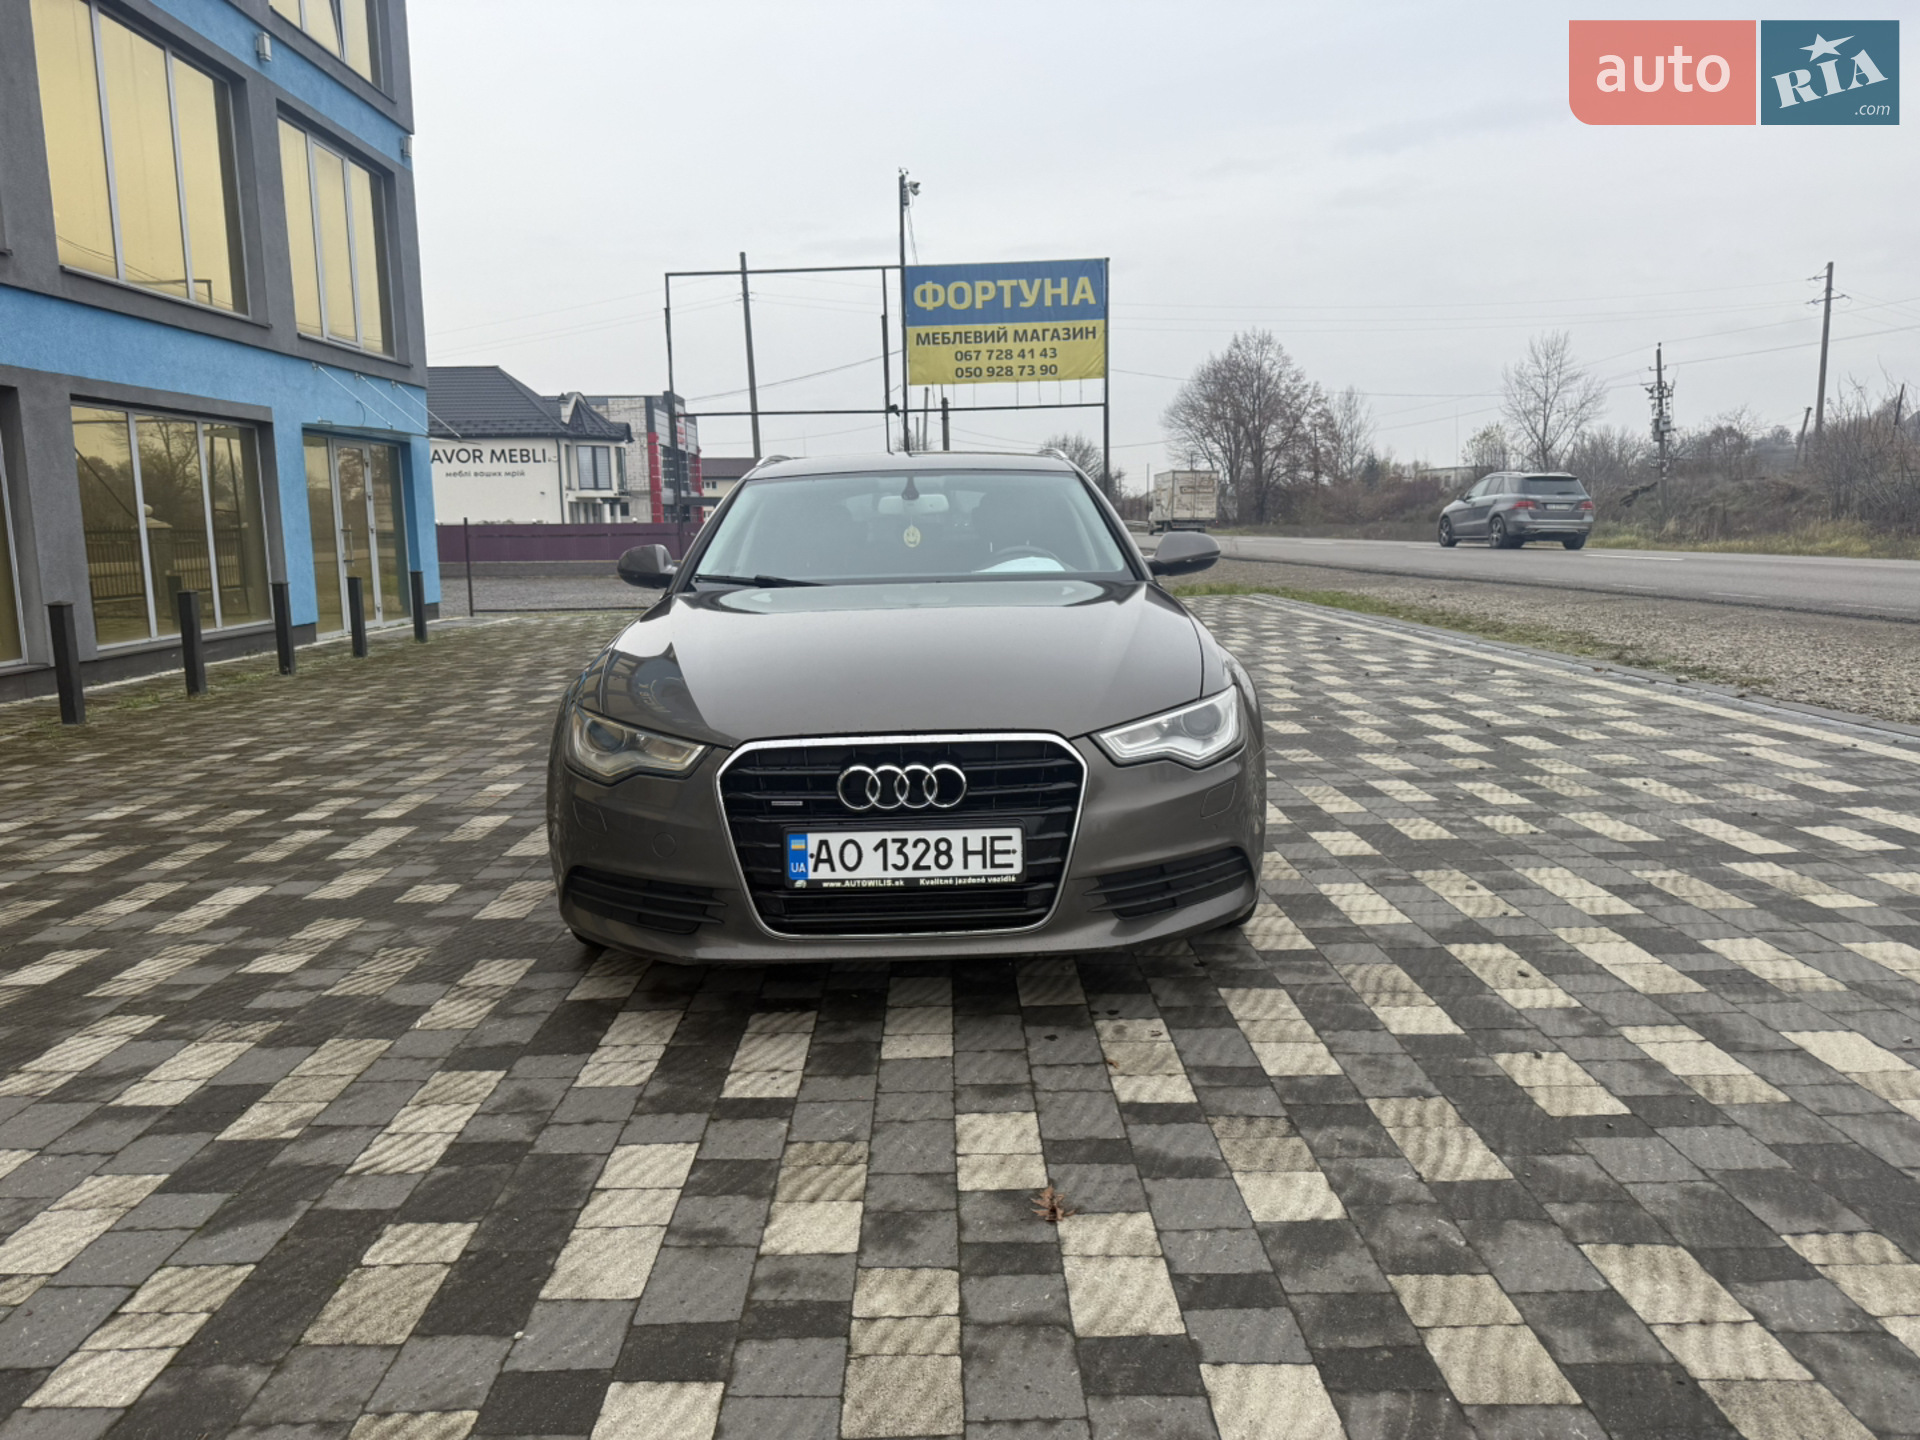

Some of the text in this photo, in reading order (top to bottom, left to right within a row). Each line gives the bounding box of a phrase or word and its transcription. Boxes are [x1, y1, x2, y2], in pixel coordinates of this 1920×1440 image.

[913, 276, 1097, 311] ФОРТУНА
[916, 326, 1097, 346] МЕБЛЕВИЙ МАГАЗИН
[955, 347, 1057, 362] 067 728 41 43
[955, 364, 1058, 378] 050 928 73 90
[489, 448, 546, 463] MEBLI
[445, 470, 471, 478] меблі
[504, 469, 525, 478] мрій
[812, 836, 1014, 873] AO 1328 HE
[790, 863, 807, 873] UA
